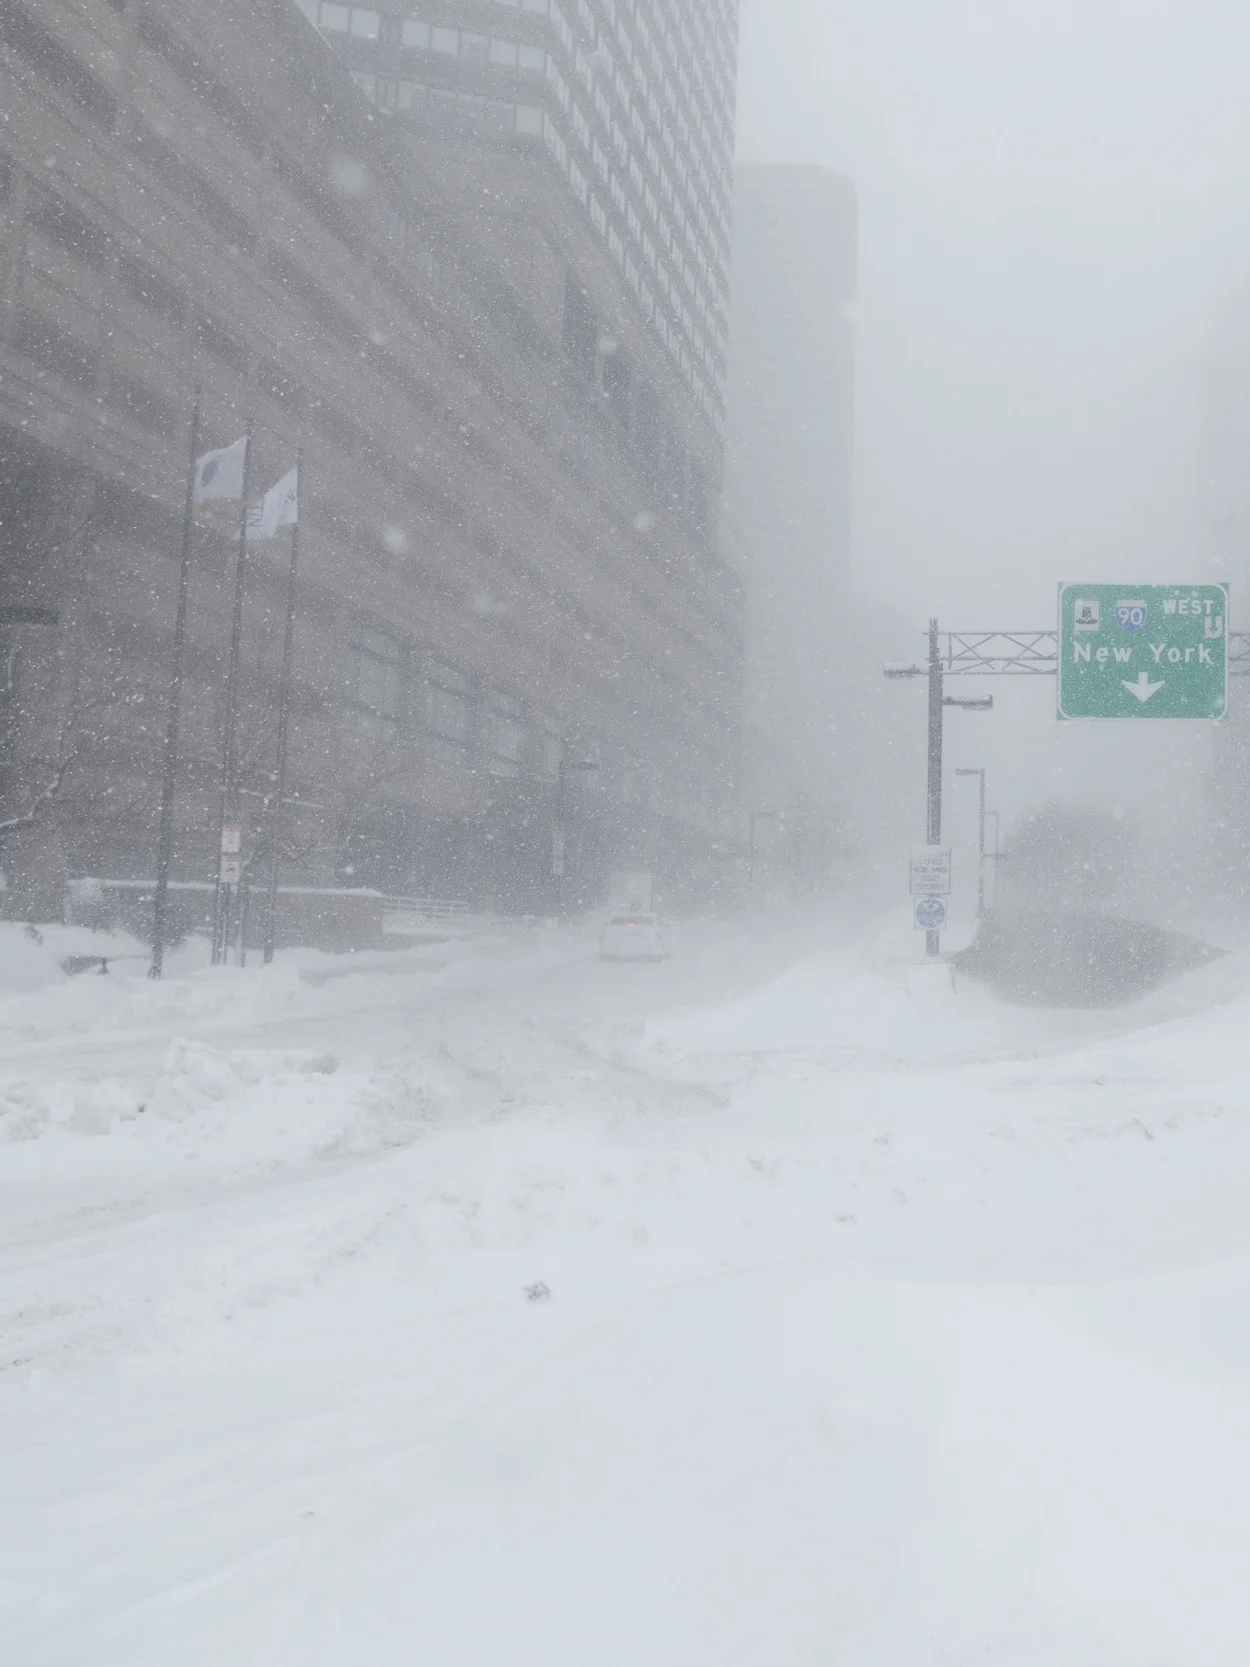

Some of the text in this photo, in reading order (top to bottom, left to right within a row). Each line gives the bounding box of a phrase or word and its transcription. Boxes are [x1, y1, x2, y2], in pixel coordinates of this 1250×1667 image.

[1118, 607, 1143, 625] 90
[1163, 599, 1214, 615] WEST
[1073, 641, 1213, 665] New York
